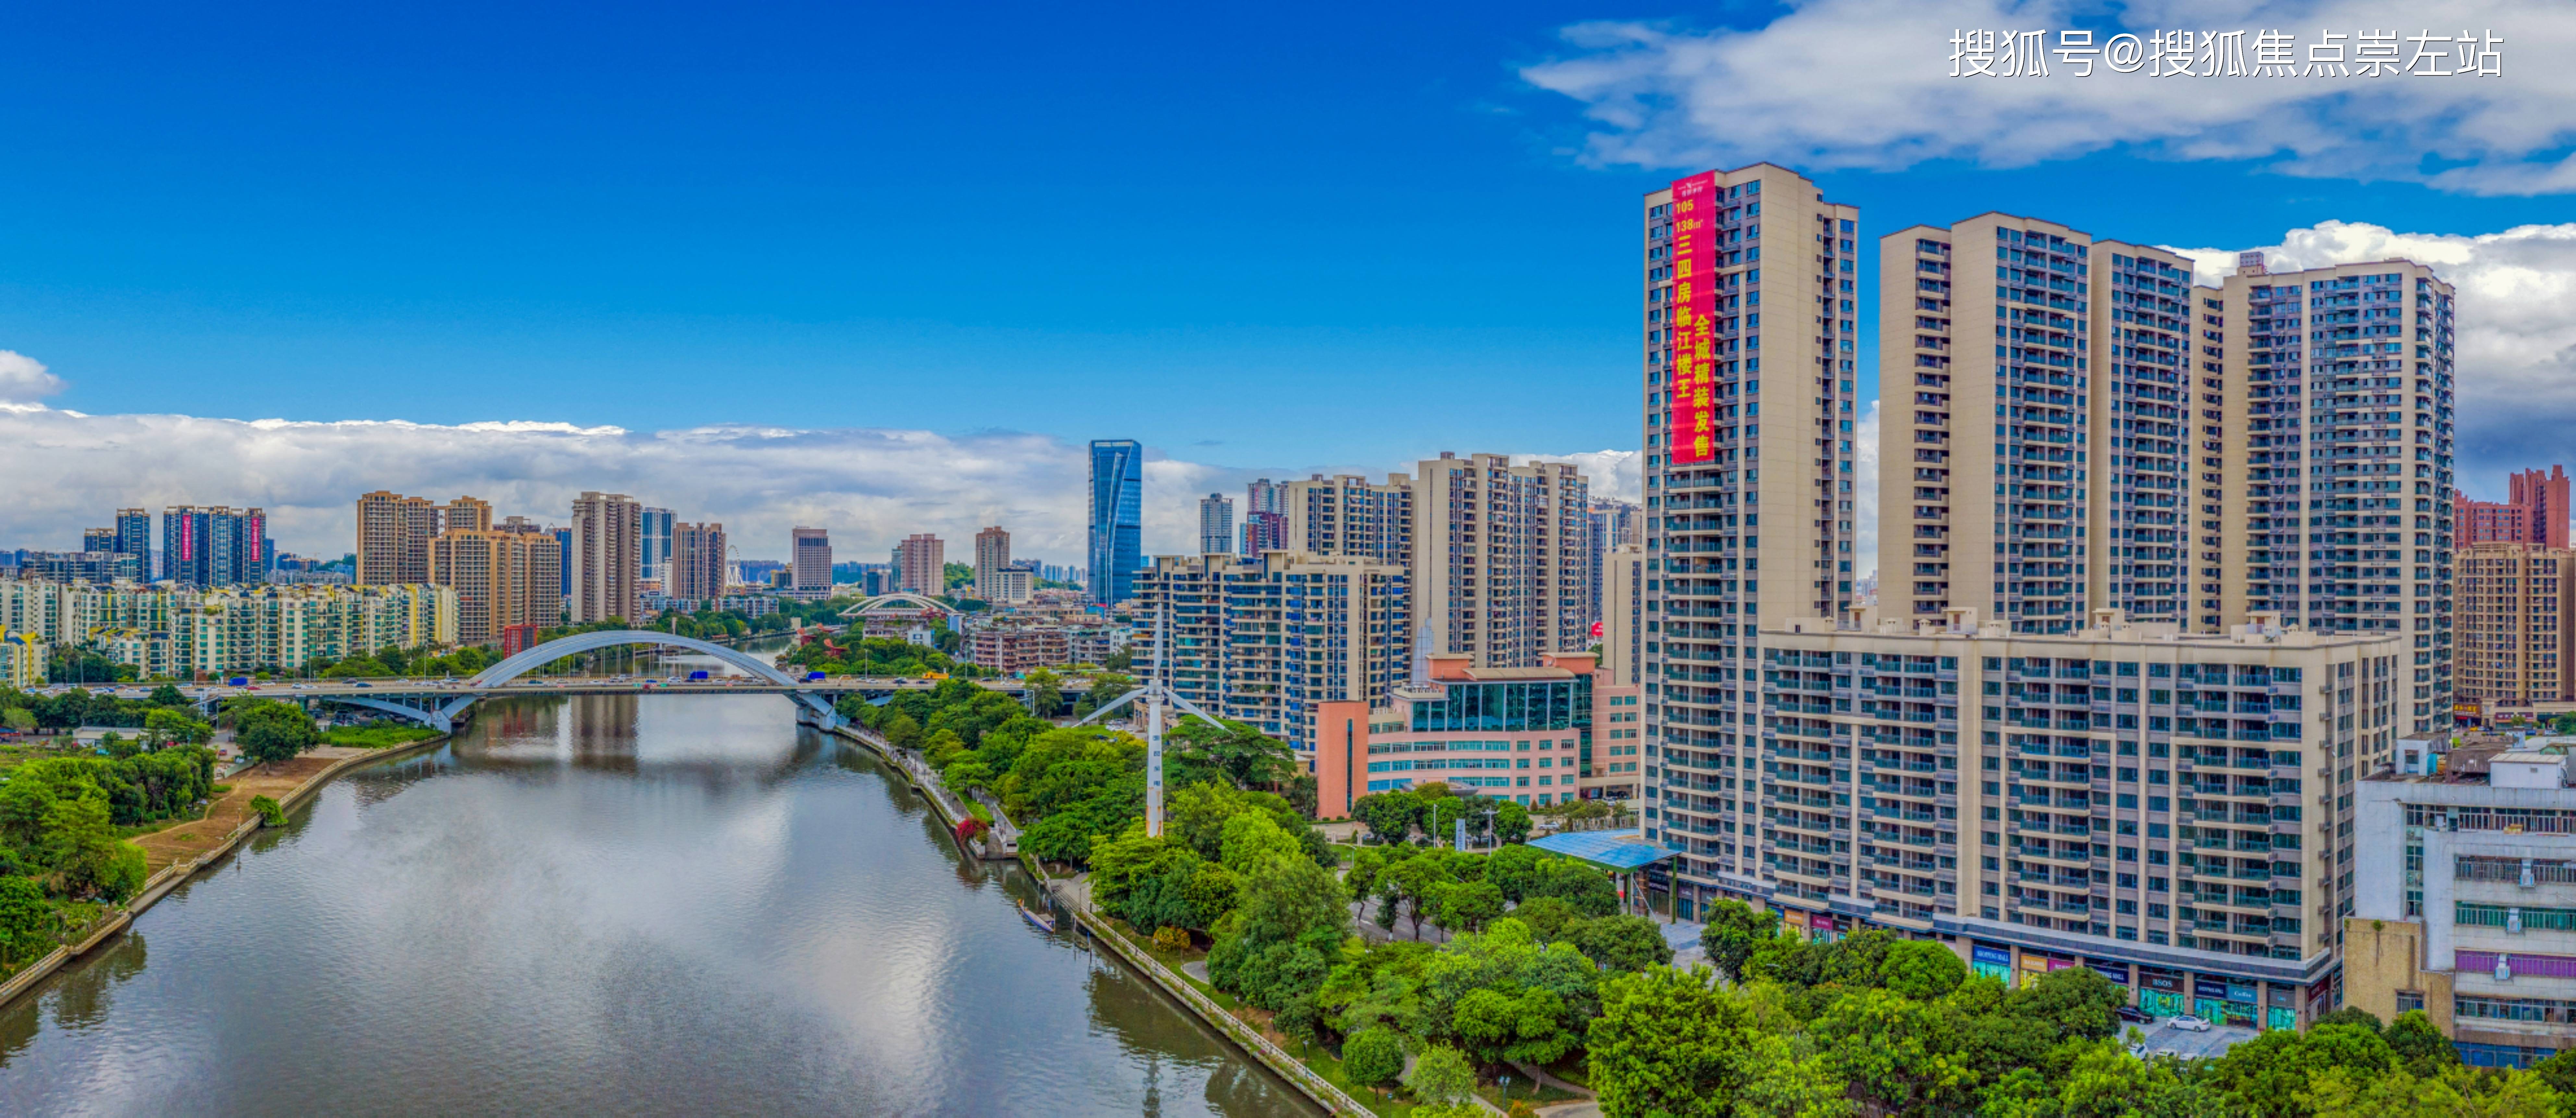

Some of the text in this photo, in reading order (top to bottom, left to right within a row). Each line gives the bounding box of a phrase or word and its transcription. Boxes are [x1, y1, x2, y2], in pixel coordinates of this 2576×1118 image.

[1677, 200, 1693, 213] 105
[1676, 235, 1692, 399] 三四房临江楼王
[1693, 314, 1711, 457] 全城精装发售
